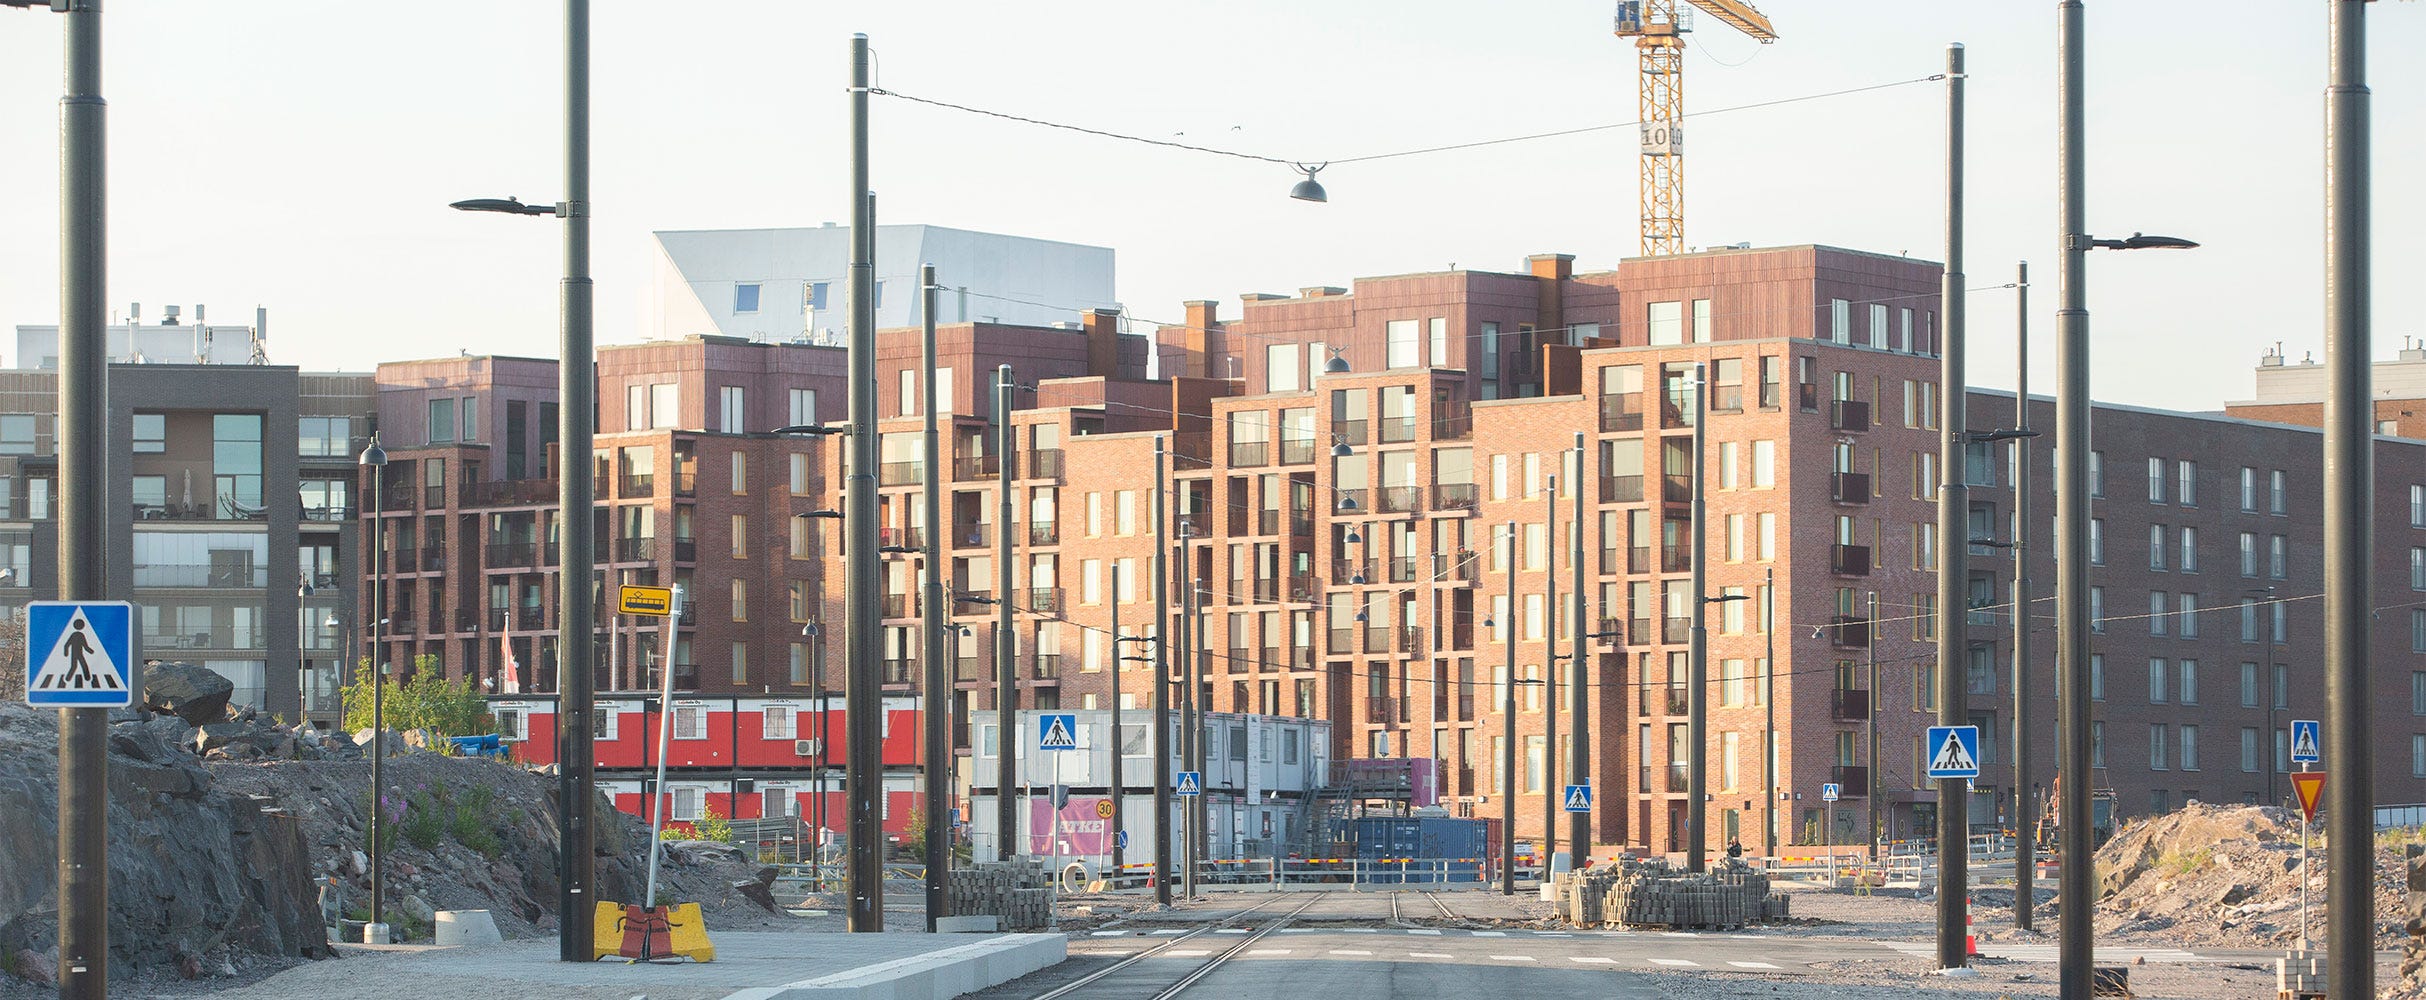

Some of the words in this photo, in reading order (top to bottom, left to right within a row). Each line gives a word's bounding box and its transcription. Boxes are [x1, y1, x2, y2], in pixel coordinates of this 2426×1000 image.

[1642, 128, 1666, 145] 10
[1671, 127, 1682, 145] 10
[1099, 803, 1112, 815] 30
[1054, 820, 1103, 834] ATKE
